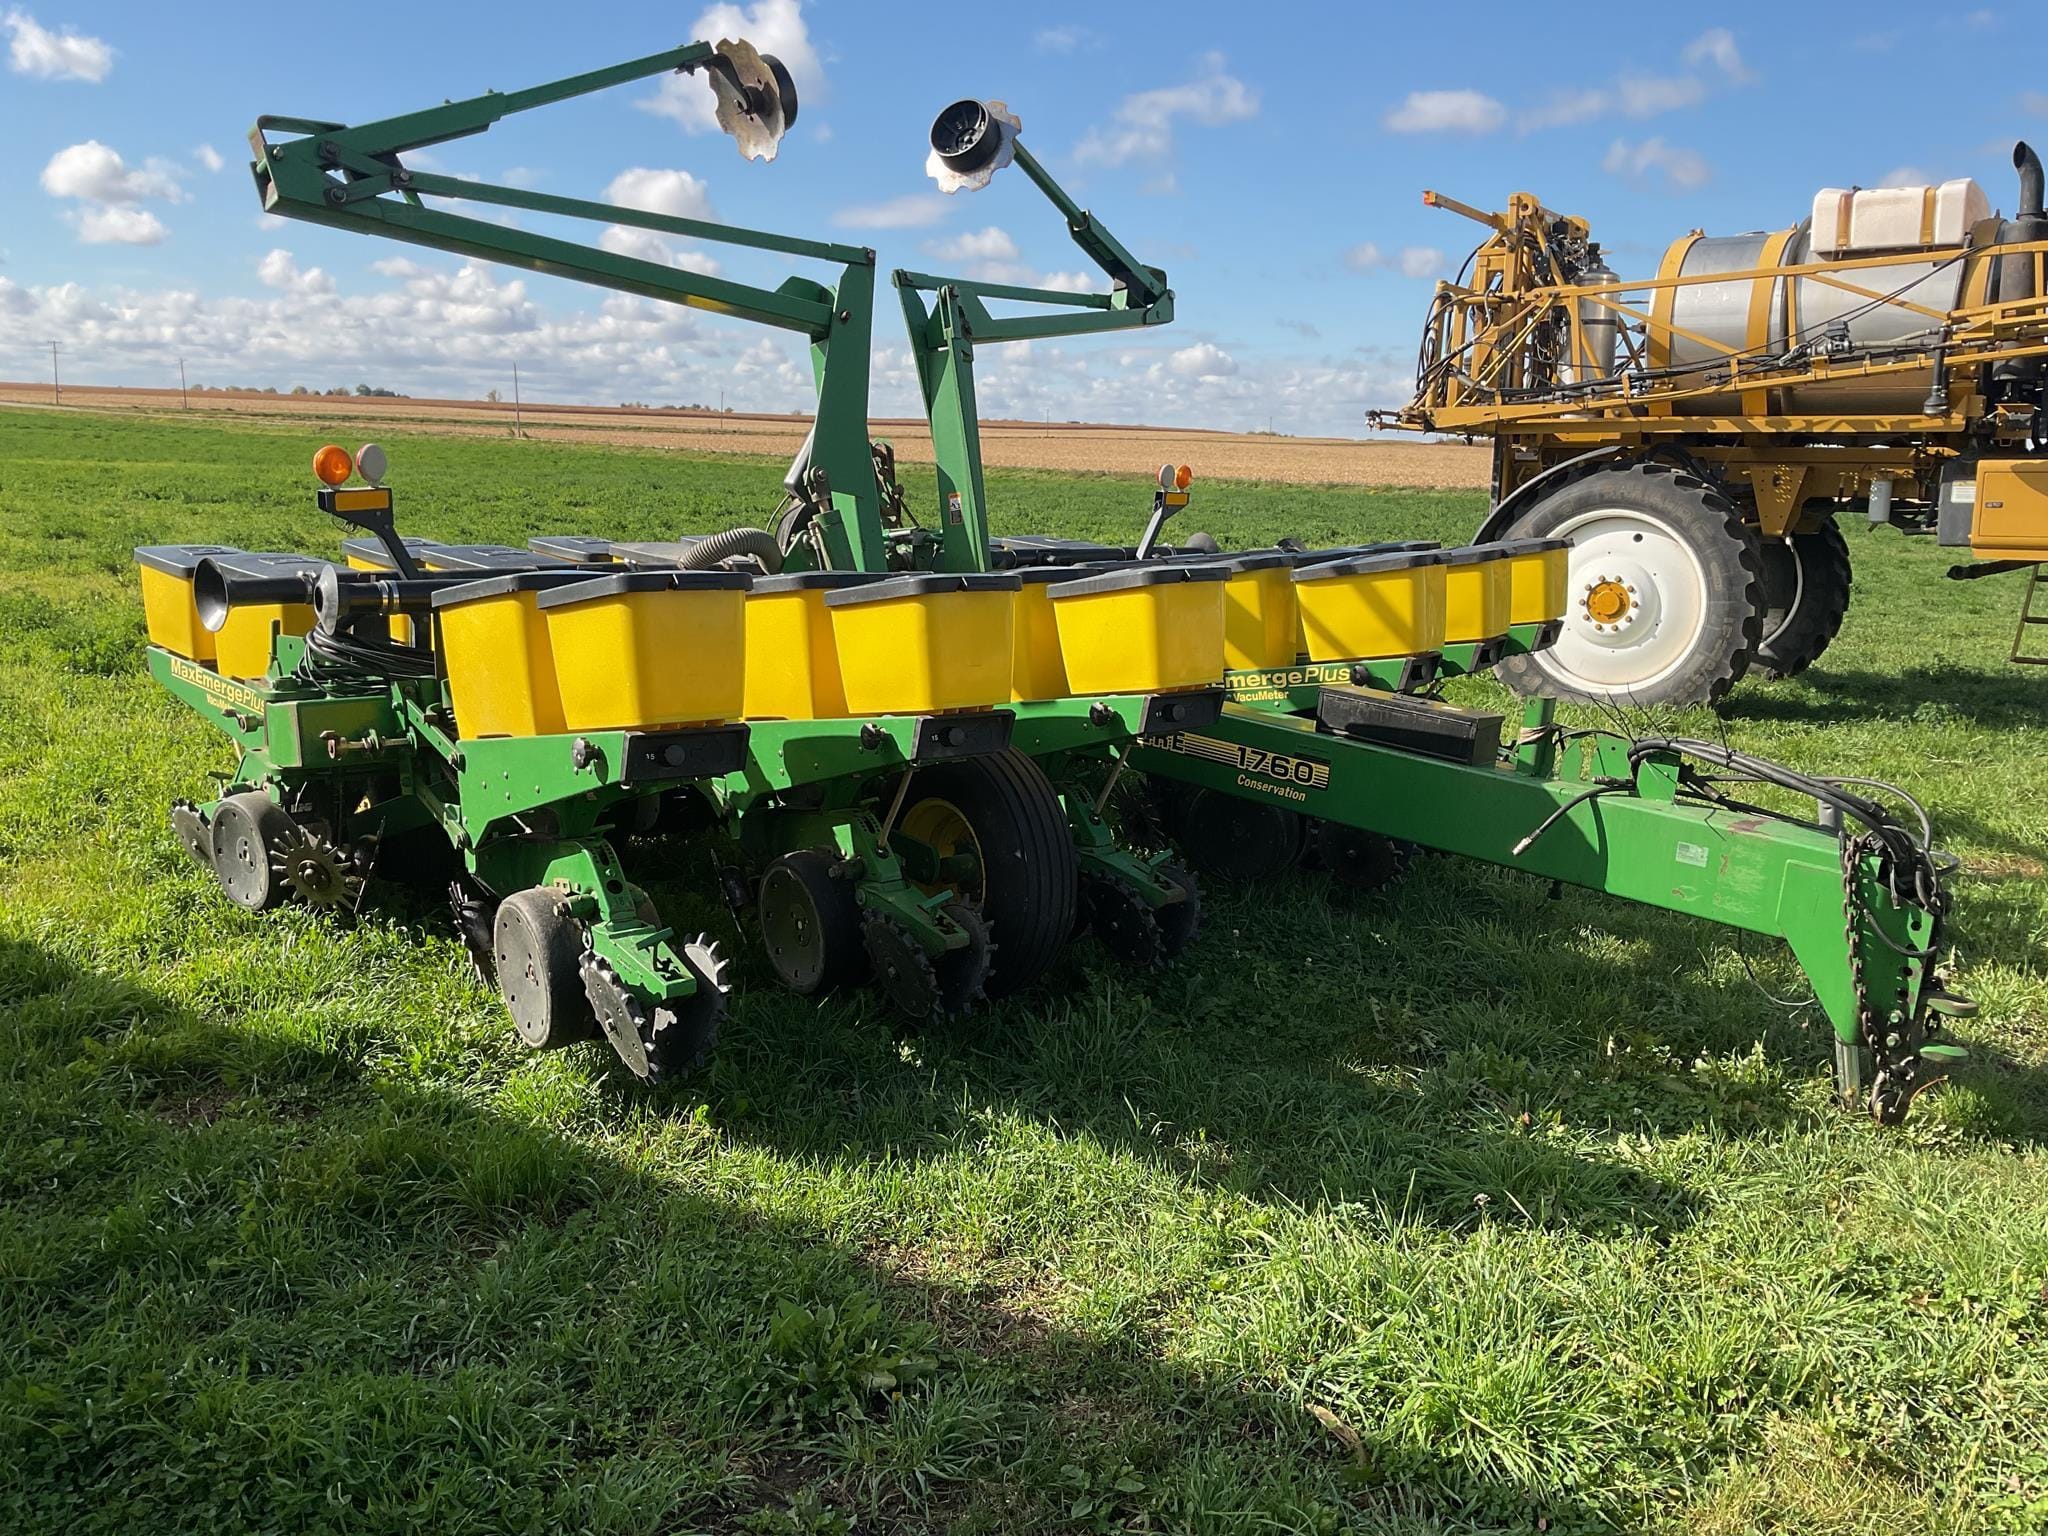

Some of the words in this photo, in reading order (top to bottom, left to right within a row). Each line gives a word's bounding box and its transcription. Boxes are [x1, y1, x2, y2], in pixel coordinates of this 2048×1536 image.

[1224, 667, 1351, 689] mergePlus
[1233, 690, 1289, 702] VacuMeter
[1237, 746, 1314, 786] 1760
[1237, 774, 1306, 801] Conservation
